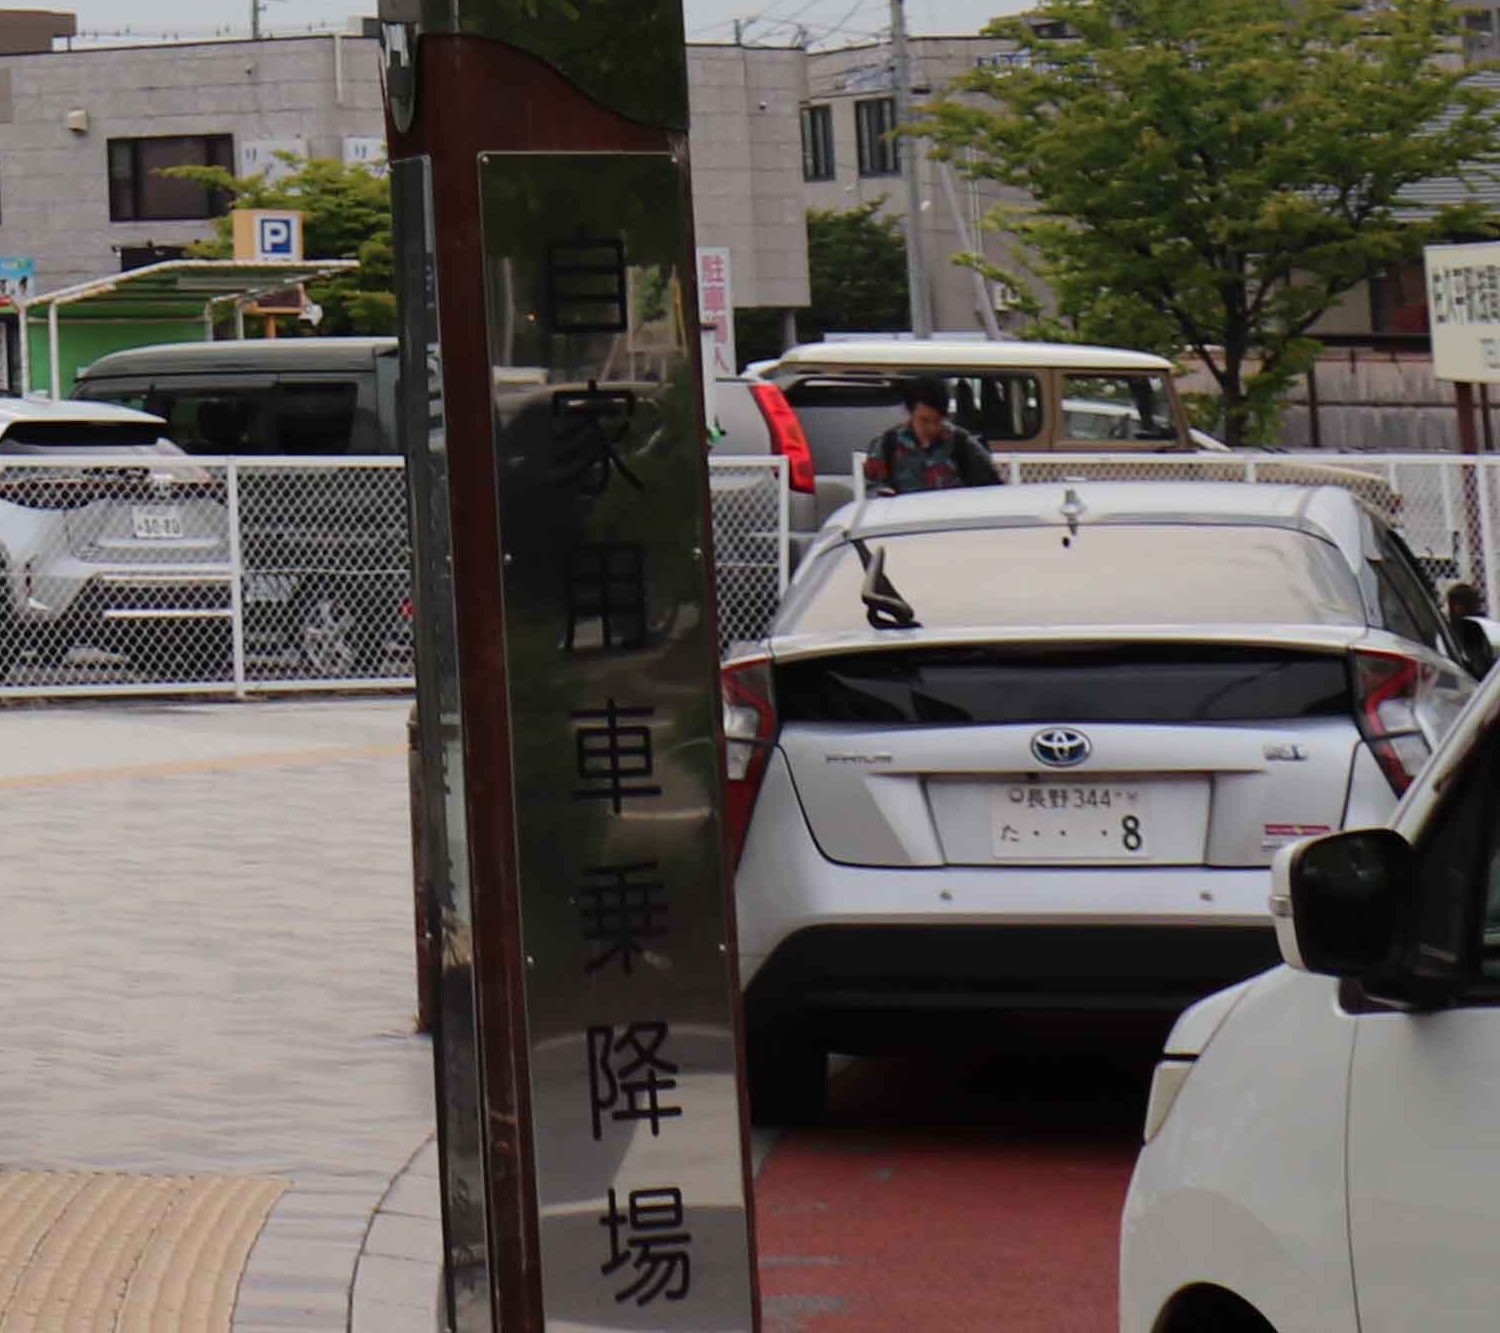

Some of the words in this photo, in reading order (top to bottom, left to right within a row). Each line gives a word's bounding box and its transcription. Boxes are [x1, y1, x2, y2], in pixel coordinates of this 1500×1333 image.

[545, 222, 693, 1309] 自家用車乗降場
